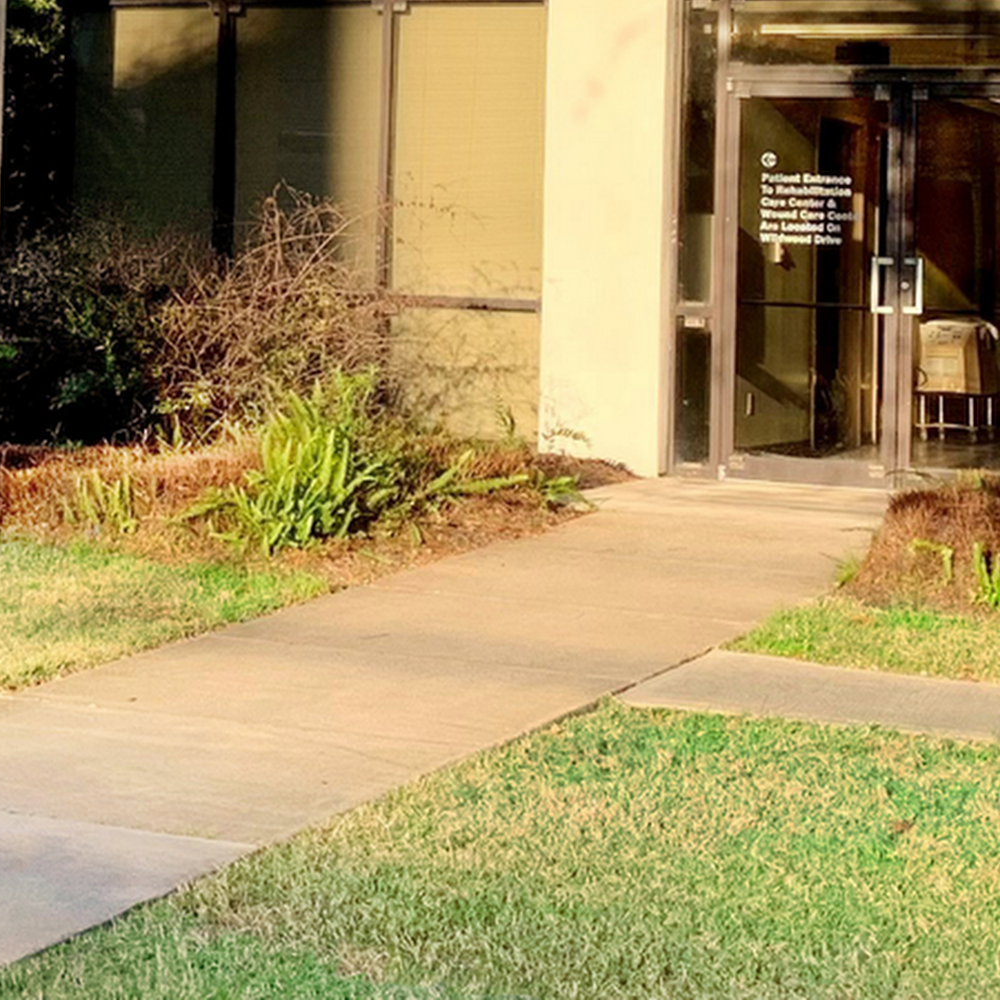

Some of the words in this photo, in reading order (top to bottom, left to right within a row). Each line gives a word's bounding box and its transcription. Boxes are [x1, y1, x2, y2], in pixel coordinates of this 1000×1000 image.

[761, 173, 800, 183] Patient
[803, 174, 852, 185] Entrance
[761, 197, 786, 208] Care
[788, 198, 825, 208] Center
[760, 209, 798, 219] Wound
[800, 210, 825, 221] Care
[827, 211, 861, 222] Cent
